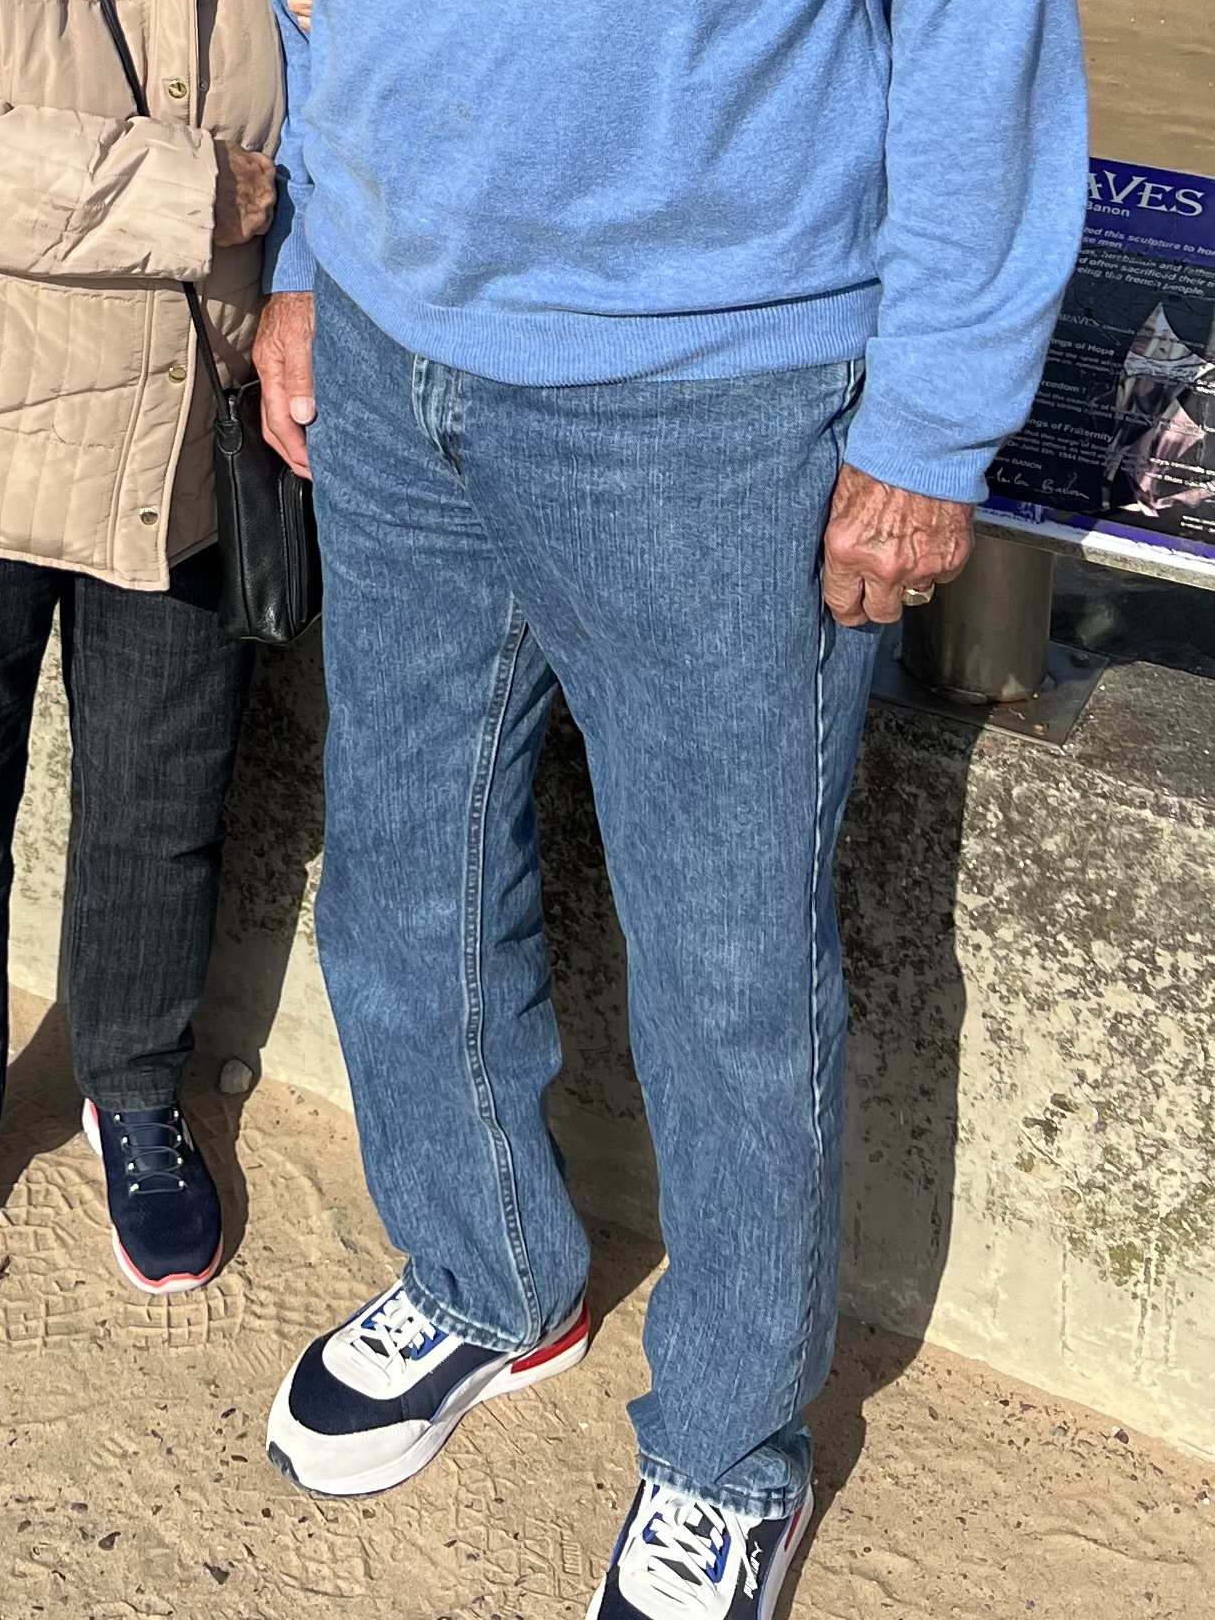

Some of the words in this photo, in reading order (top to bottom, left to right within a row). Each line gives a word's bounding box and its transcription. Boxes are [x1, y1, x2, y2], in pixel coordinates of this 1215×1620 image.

[1098, 239, 1123, 248] men
[1104, 229, 1125, 240] this
[1127, 234, 1181, 250] sculpture
[1183, 244, 1195, 253] to
[1064, 424, 1113, 443] Fraternity
